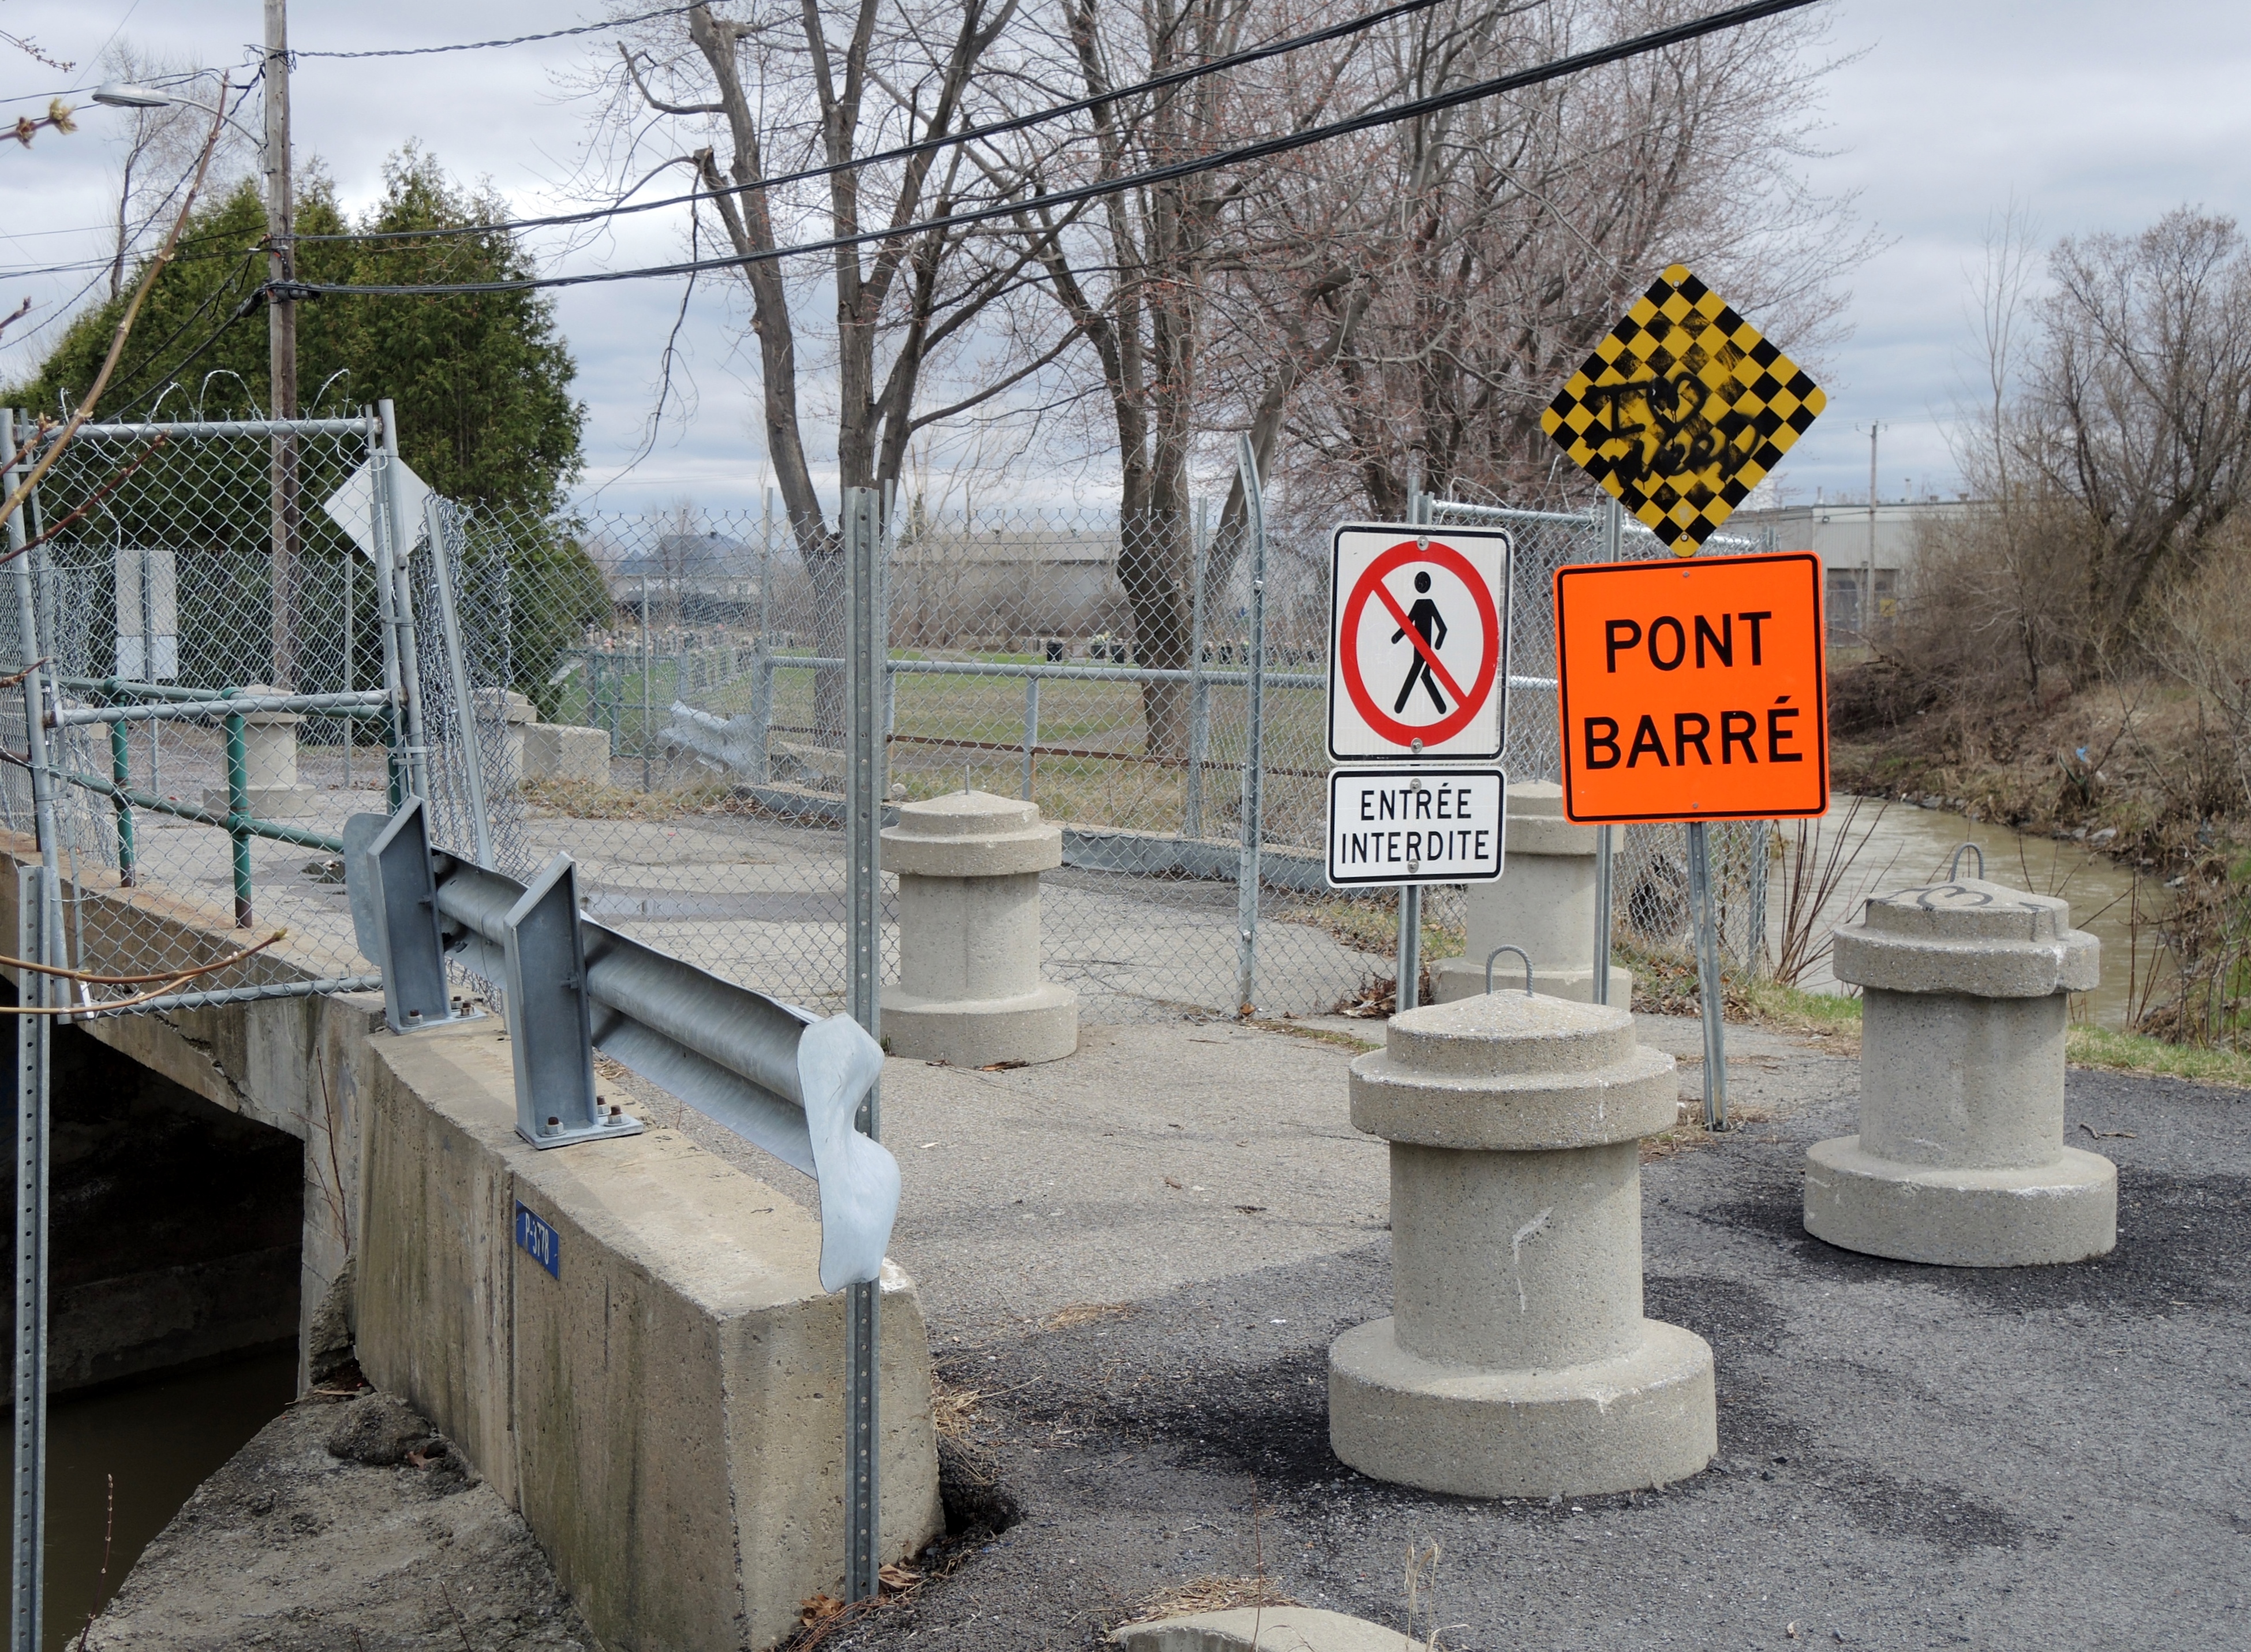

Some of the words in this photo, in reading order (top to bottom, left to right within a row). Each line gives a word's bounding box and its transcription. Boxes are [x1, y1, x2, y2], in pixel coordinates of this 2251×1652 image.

[1605, 611, 1772, 674] PONT
[1584, 695, 1803, 770] BARRÉ
[1360, 783, 1472, 821] ENTRÉE
[1341, 830, 1490, 864] INTERDITE
[525, 1212, 549, 1265] P-3778
